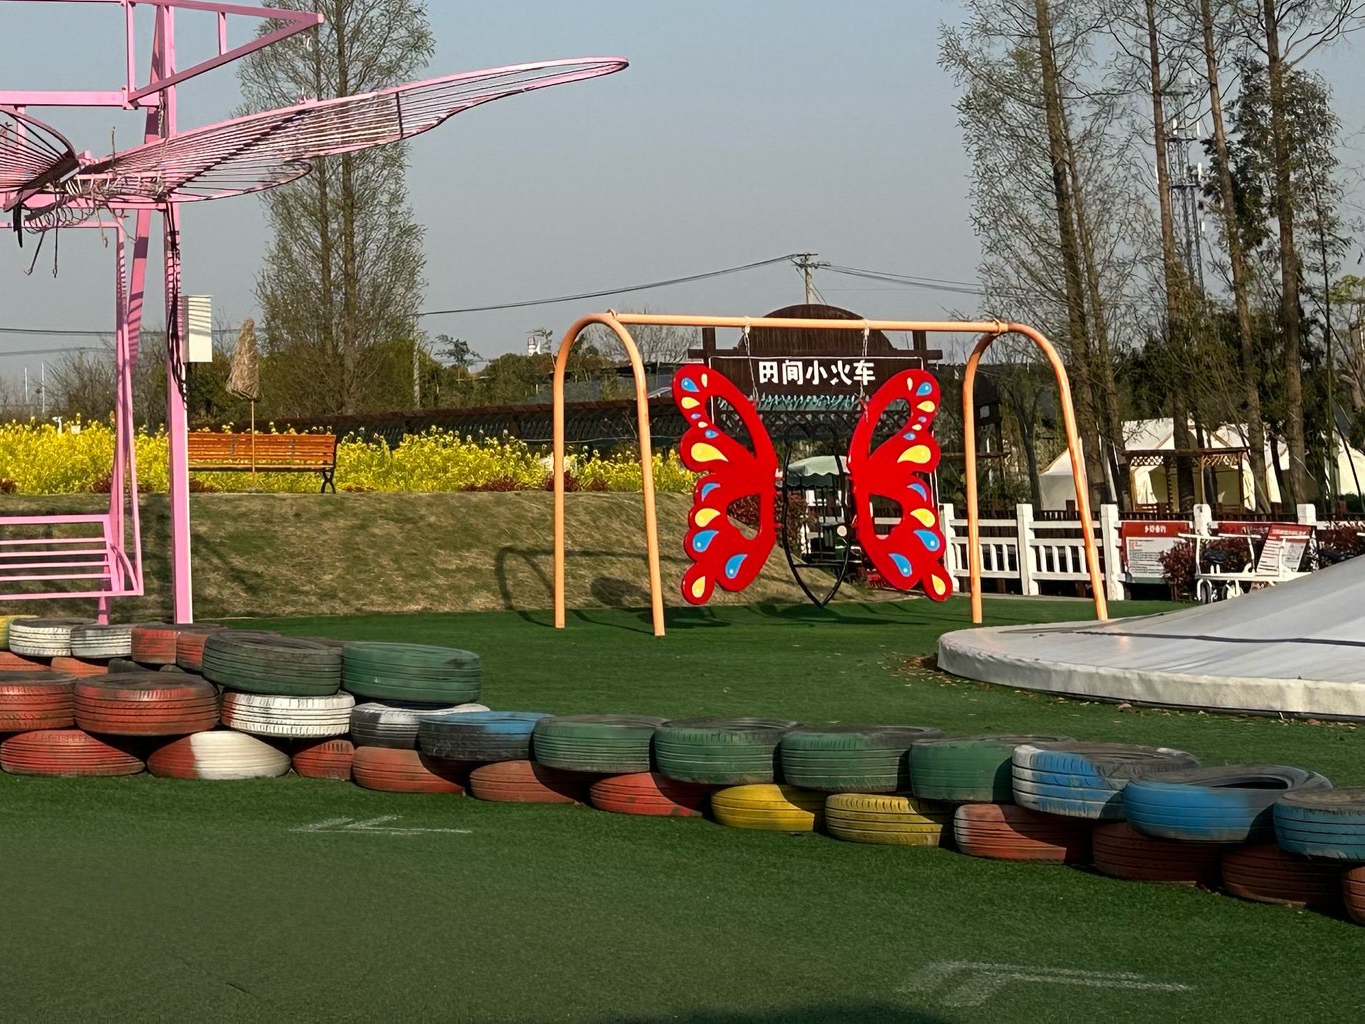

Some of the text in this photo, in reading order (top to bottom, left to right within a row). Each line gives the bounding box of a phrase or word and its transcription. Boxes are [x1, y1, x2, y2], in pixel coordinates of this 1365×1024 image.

[758, 359, 876, 386] 田间小火车
